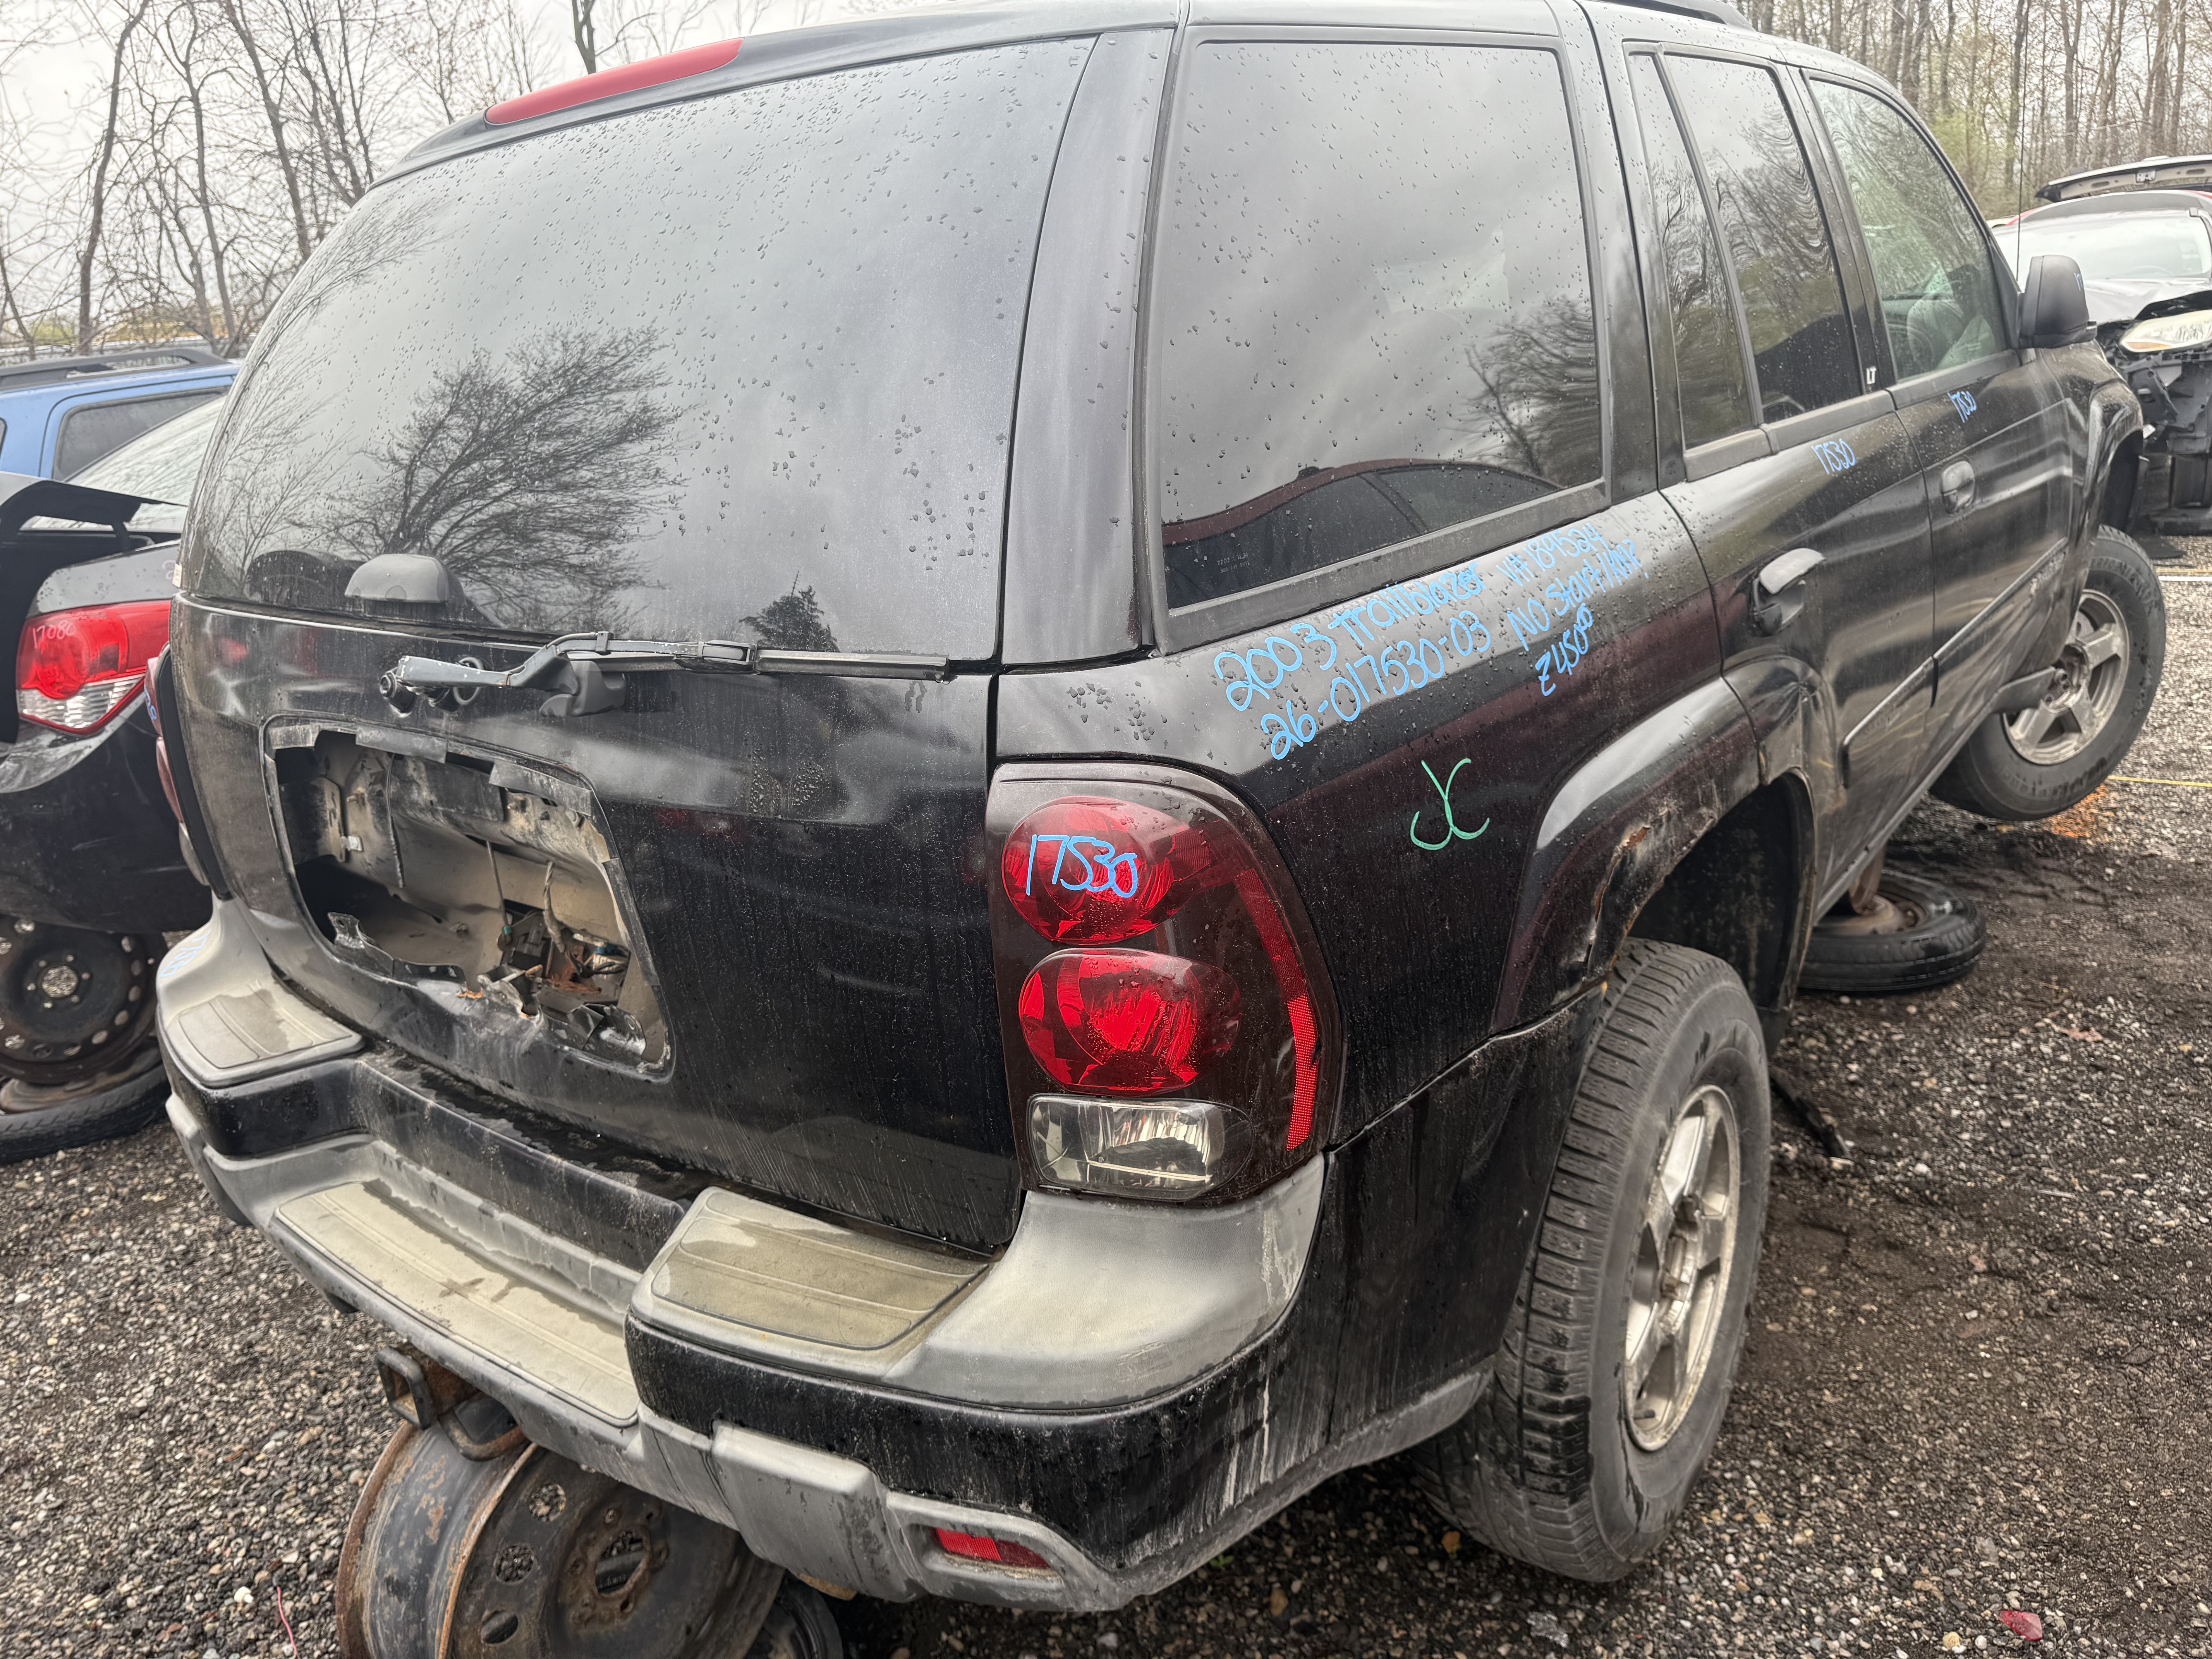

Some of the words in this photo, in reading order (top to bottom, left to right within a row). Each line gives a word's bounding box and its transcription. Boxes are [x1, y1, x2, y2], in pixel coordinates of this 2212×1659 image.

[1866, 366, 1877, 385] LT
[1947, 390, 1977, 423] 17530
[1811, 438, 1856, 475] 17530
[1214, 623, 1337, 711] 2003
[1522, 522, 1614, 572] 189524
[1261, 610, 1491, 760] 26-017530-03
[1026, 834, 1139, 898] 17530
